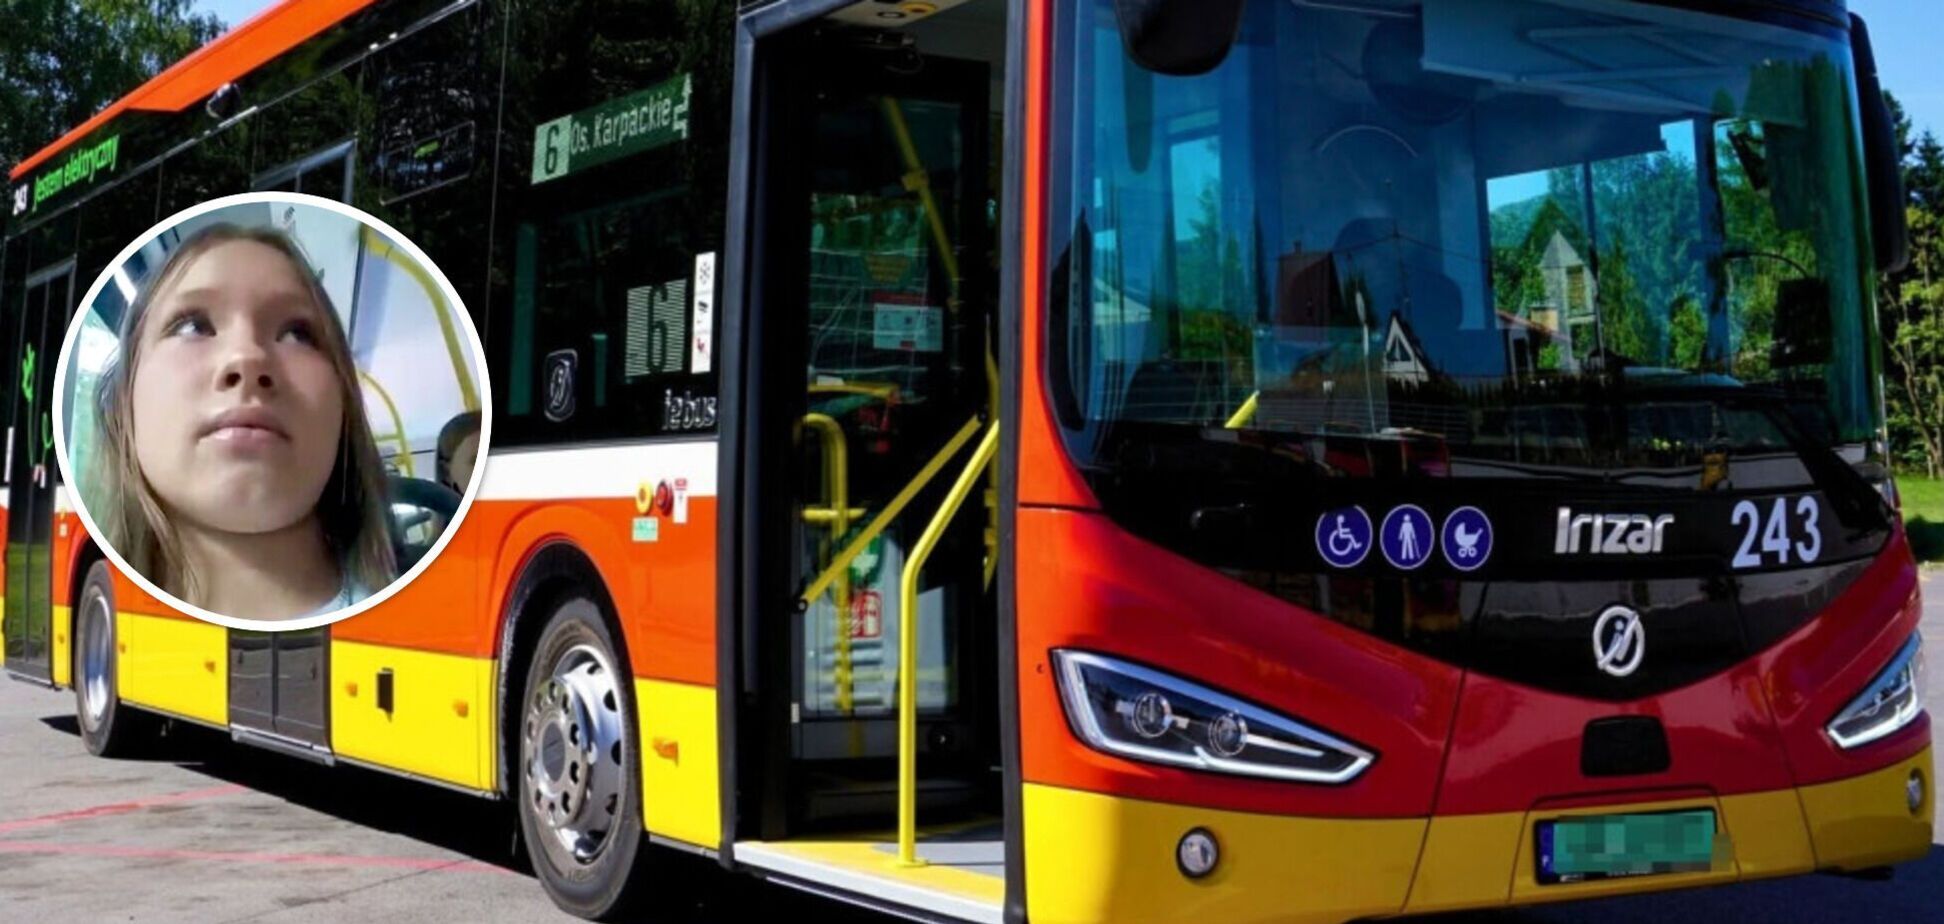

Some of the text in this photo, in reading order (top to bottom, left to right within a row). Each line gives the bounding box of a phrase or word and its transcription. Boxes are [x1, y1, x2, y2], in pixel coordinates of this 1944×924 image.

[12, 183, 29, 216] 243
[65, 134, 119, 187] elektryczny
[544, 124, 560, 175] 6
[593, 93, 671, 147] Karpackie
[646, 281, 669, 373] 6
[1555, 508, 1674, 554] Irizar
[1731, 496, 1821, 568] 243
